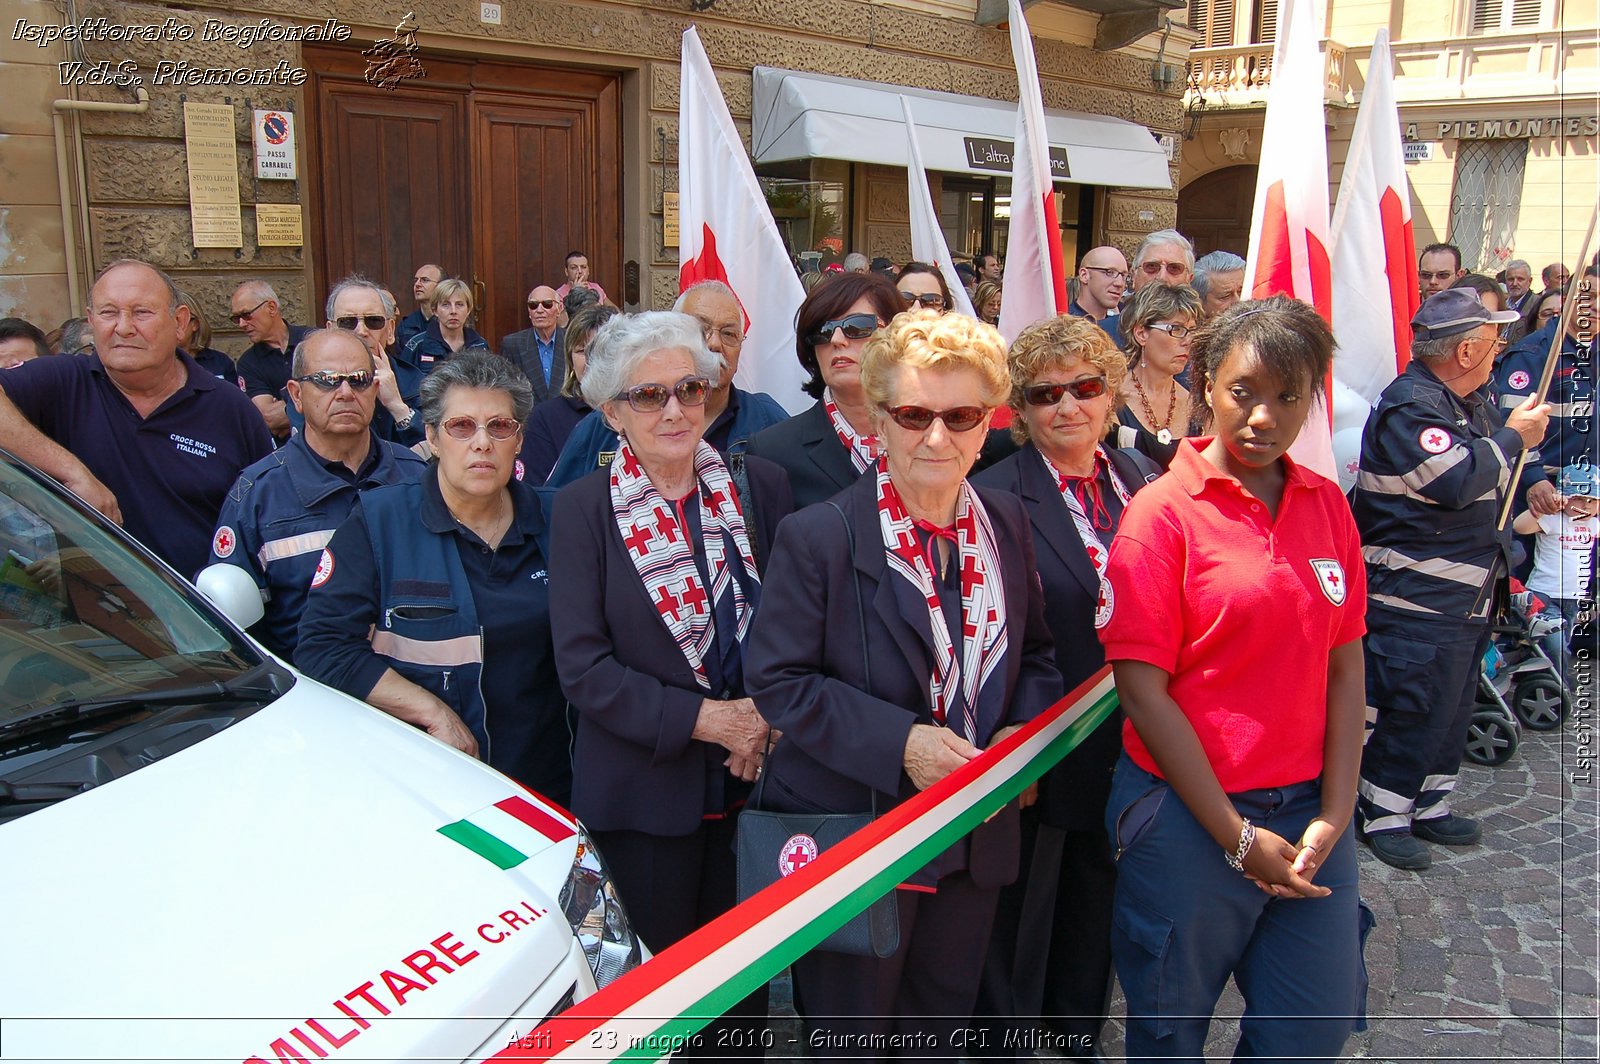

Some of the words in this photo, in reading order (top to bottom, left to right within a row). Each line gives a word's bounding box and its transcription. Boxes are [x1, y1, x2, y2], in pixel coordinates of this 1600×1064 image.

[484, 7, 498, 19] 29
[267, 150, 286, 158] PASSO
[970, 141, 1010, 164] L'altra
[261, 161, 292, 169] CARRABILE
[170, 433, 194, 446] CROCE
[194, 441, 217, 454] ROSSA
[176, 443, 208, 458] ITALIANA
[477, 901, 548, 944] C.R.I.
